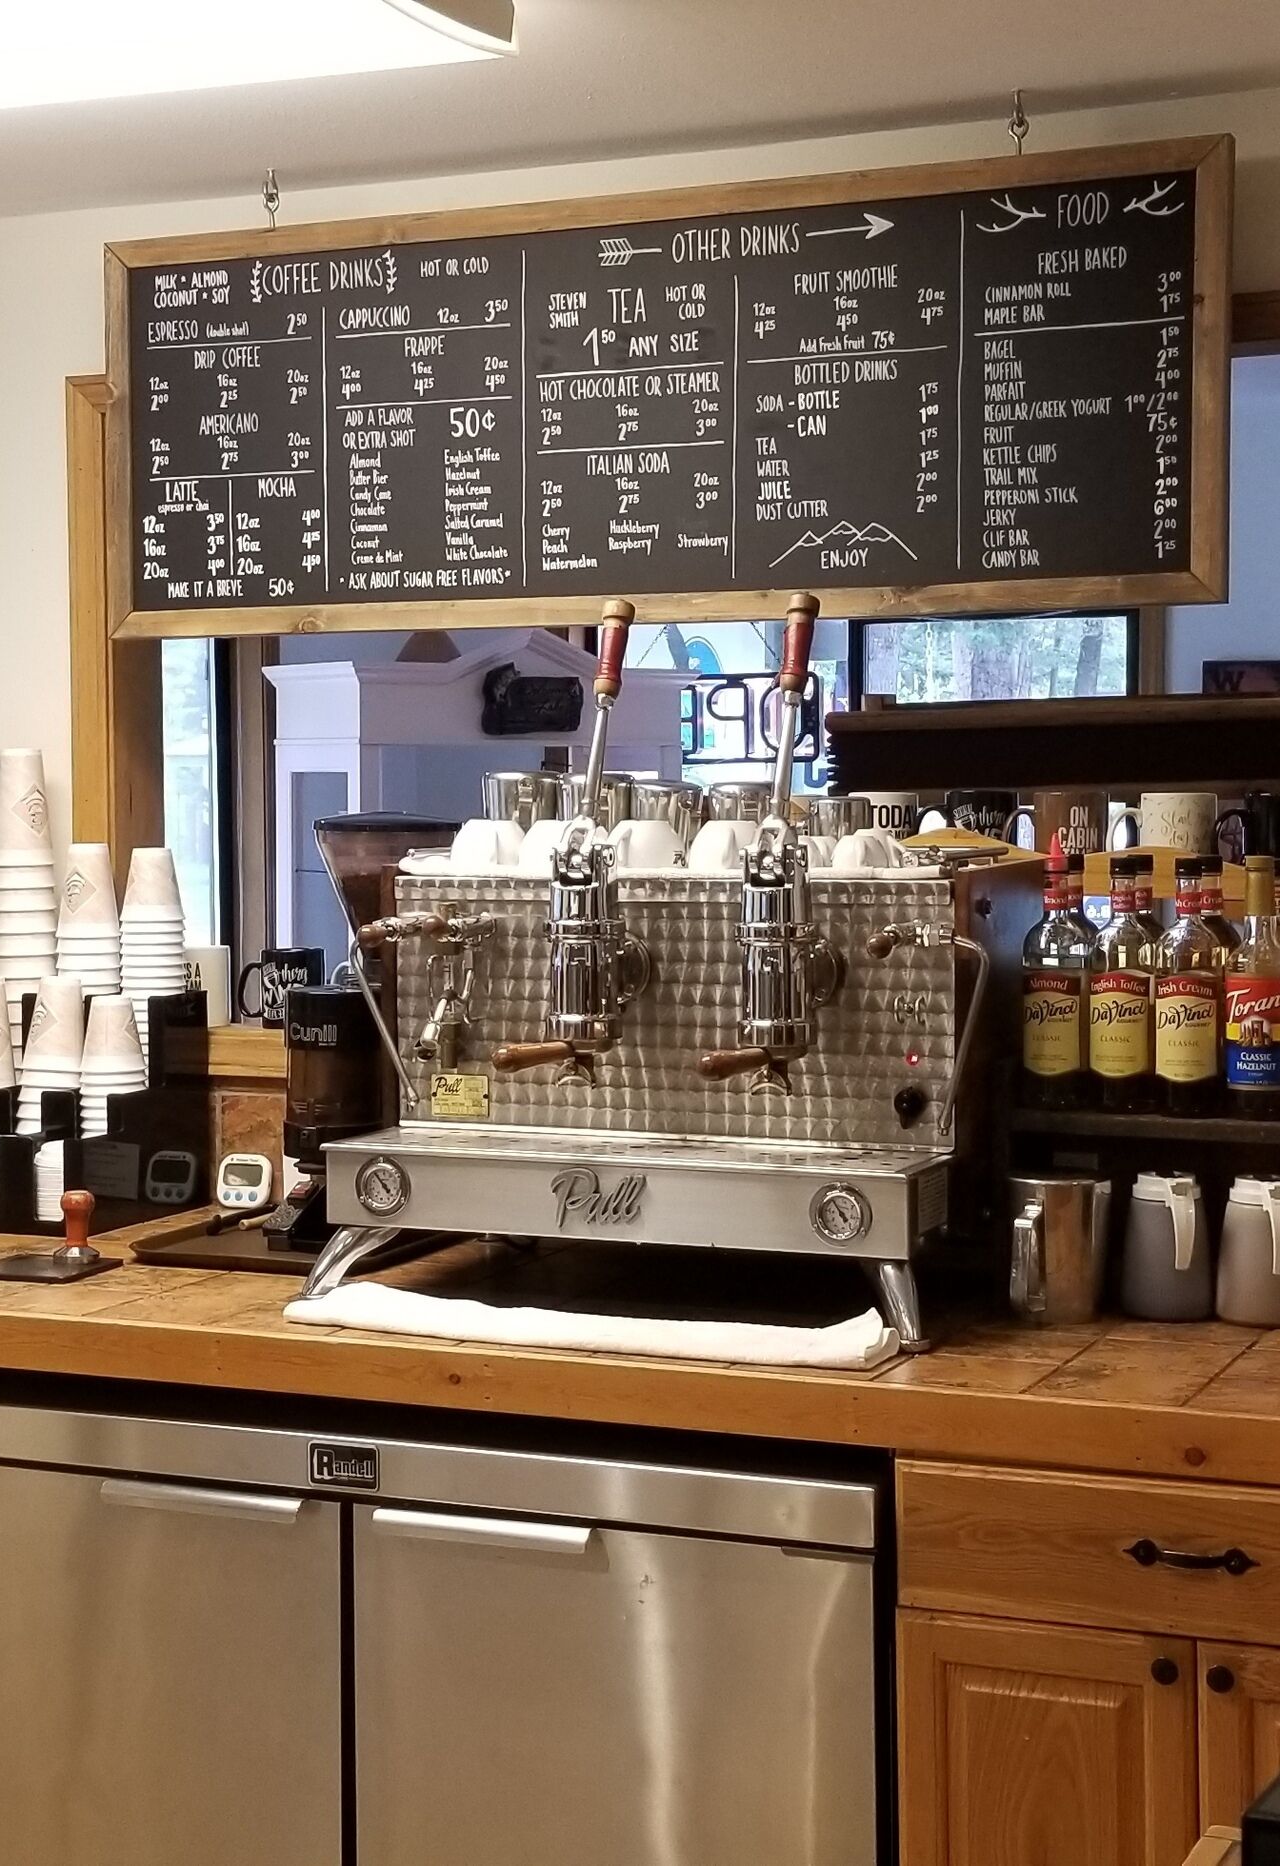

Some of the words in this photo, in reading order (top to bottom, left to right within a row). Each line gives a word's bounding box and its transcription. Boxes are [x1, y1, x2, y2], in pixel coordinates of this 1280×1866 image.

[1058, 192, 1109, 228] FOOD
[671, 227, 731, 264] OTHER
[740, 222, 800, 257] DRINKS
[420, 258, 442, 278] HOT
[445, 258, 460, 277] OR
[463, 256, 490, 275] COLD
[1038, 249, 1079, 275] FRESH
[1085, 246, 1127, 271] BAKED
[154, 273, 178, 292] MILK
[190, 269, 229, 289] ALMOND
[262, 261, 322, 296] COFFEE
[329, 257, 384, 291] DRINKS
[794, 271, 831, 295] FRUIT
[835, 263, 898, 293] SMOOTHIE
[153, 288, 199, 309] COCONUT
[211, 284, 231, 305] SOY
[548, 290, 587, 312] STEVEN
[665, 284, 688, 303] HOT
[691, 283, 707, 301] OR
[985, 282, 1043, 304] CINNAMON
[1047, 282, 1072, 299] ROLL
[606, 287, 647, 324] TEA
[678, 302, 706, 321] COLD
[984, 306, 1018, 326] MAPLE
[1023, 304, 1045, 323] BAR
[339, 304, 411, 330] CAPPUCCINO
[549, 310, 580, 329] SMITH
[148, 319, 199, 344] ESPRESSO
[404, 334, 446, 358] FRAPPE
[628, 334, 659, 358] ANY
[669, 330, 700, 353] SIZE
[798, 337, 818, 354] Add
[818, 335, 843, 353] Fresh
[843, 334, 865, 350] Fruit
[984, 339, 1016, 360] BAGEL
[194, 349, 216, 370] DRIP
[221, 345, 261, 370] COFFEE
[794, 361, 850, 386] BOTTLED
[854, 359, 898, 383] DRINKS
[984, 360, 1023, 381] MUFFIN
[539, 379, 566, 403] HOT
[569, 375, 640, 401] CHOCOLATE
[644, 375, 663, 397] OR
[666, 371, 721, 395] STEAMER
[984, 380, 1026, 402] PARFAIT
[755, 394, 784, 414] SODA
[1070, 397, 1112, 417] YOGURT
[198, 412, 259, 436] AMERICANO
[344, 409, 364, 427] ADD
[367, 408, 376, 427] A
[377, 406, 414, 427] FLAVOR
[342, 431, 358, 450] OR
[357, 430, 388, 450] EXTRA
[389, 428, 417, 448] SHOT
[983, 425, 1014, 444] FRUIT
[755, 436, 778, 456] TEA
[982, 446, 1021, 466] KETTLE
[1027, 443, 1057, 464] CHIPS
[348, 450, 382, 469] Almond
[444, 448, 474, 469] English
[473, 446, 501, 462] Toffee
[586, 453, 634, 476] ITALIAN
[637, 450, 671, 474] SODA
[445, 466, 481, 481] Hazelnut
[756, 459, 791, 478] WATER
[983, 467, 1014, 487] TRAIL
[1017, 466, 1039, 486] MIX
[165, 482, 199, 502] LATTE
[257, 476, 297, 499] MOCHA
[445, 482, 465, 497] Irish
[465, 481, 492, 496] Cream
[757, 480, 793, 501] JUICE
[984, 488, 1040, 506] PEPPERONI
[1044, 486, 1078, 503] STICK
[349, 501, 386, 517] Chocolate
[444, 497, 489, 518] Peppermint
[755, 501, 784, 522] DUST
[786, 499, 829, 520] CUTTER
[982, 508, 1017, 526] JERKY
[349, 518, 389, 535] Cinnamon
[444, 514, 471, 530] Salted
[469, 512, 504, 529] Caramel
[609, 519, 660, 540] Huckleberry
[350, 534, 381, 550] Coconut
[445, 531, 475, 546] Vanilla
[541, 523, 571, 541] Cherry
[982, 529, 1006, 548] CLIF
[1008, 528, 1030, 547] BAR
[445, 547, 469, 562] White
[468, 544, 509, 561] Chocolate
[542, 537, 569, 555] Peach
[608, 536, 652, 556] Raspberry
[677, 532, 729, 557] Strawberry
[541, 553, 598, 572] Watermelon
[820, 547, 869, 570] ENJOY
[981, 549, 1017, 569] CANDY
[1019, 549, 1040, 567] BAR
[167, 581, 190, 599] MAKE
[193, 580, 204, 598] IT
[206, 580, 214, 598] A
[216, 578, 244, 598] BREVE
[348, 572, 368, 591] ASK
[369, 569, 401, 590] ABOUT
[403, 570, 434, 589] SUGAR
[435, 568, 458, 588] FREE
[461, 566, 505, 587] FLAVORS
[1070, 805, 1089, 828] ON
[1057, 826, 1098, 849] CABIN
[1029, 978, 1069, 991] Almond
[1091, 979, 1118, 993] English
[1119, 979, 1147, 994] Toffee
[1157, 981, 1178, 997] Irish
[1179, 981, 1214, 998] Cream
[1236, 1061, 1276, 1072] HAZELNUT
[1240, 1051, 1272, 1062] CLASSIC
[435, 1076, 463, 1095] Pull
[551, 1166, 647, 1229] Pull
[313, 1448, 375, 1479] Randell
